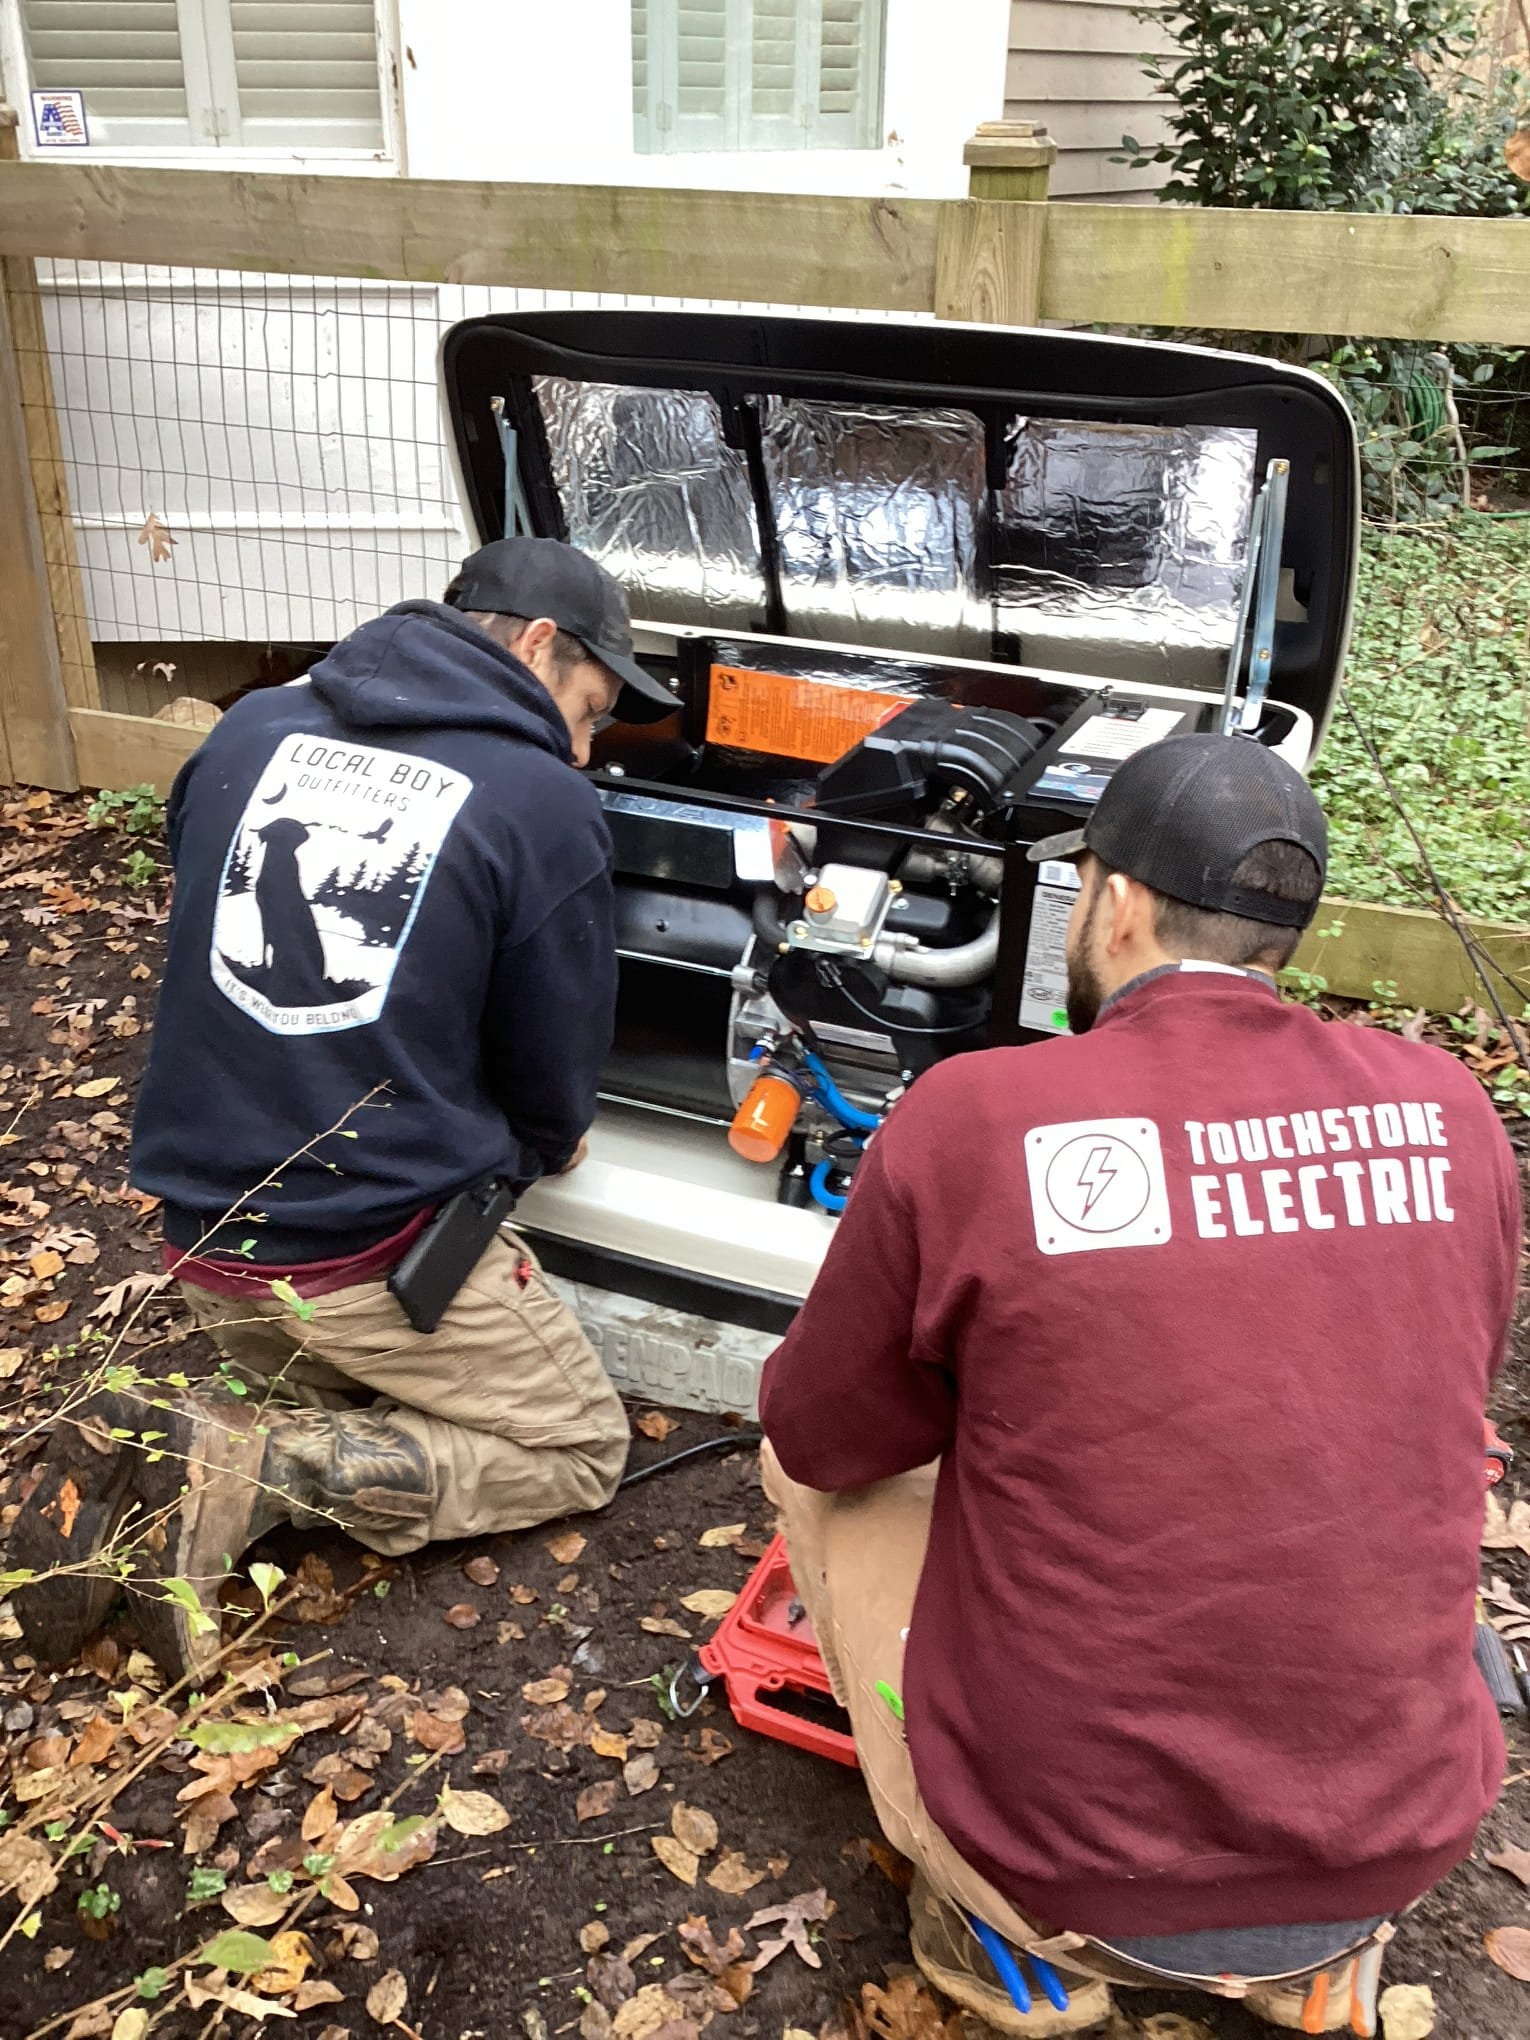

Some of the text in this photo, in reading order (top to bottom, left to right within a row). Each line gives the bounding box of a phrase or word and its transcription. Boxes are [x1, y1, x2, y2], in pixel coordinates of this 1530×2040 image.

[290, 743, 455, 798] LOCAL BOY
[297, 774, 410, 812] OUTFITTERS
[272, 1013, 299, 1025] YOU
[1184, 1102, 1448, 1165] TOUCHSTONE
[1190, 1156, 1454, 1238] ELECTRIC
